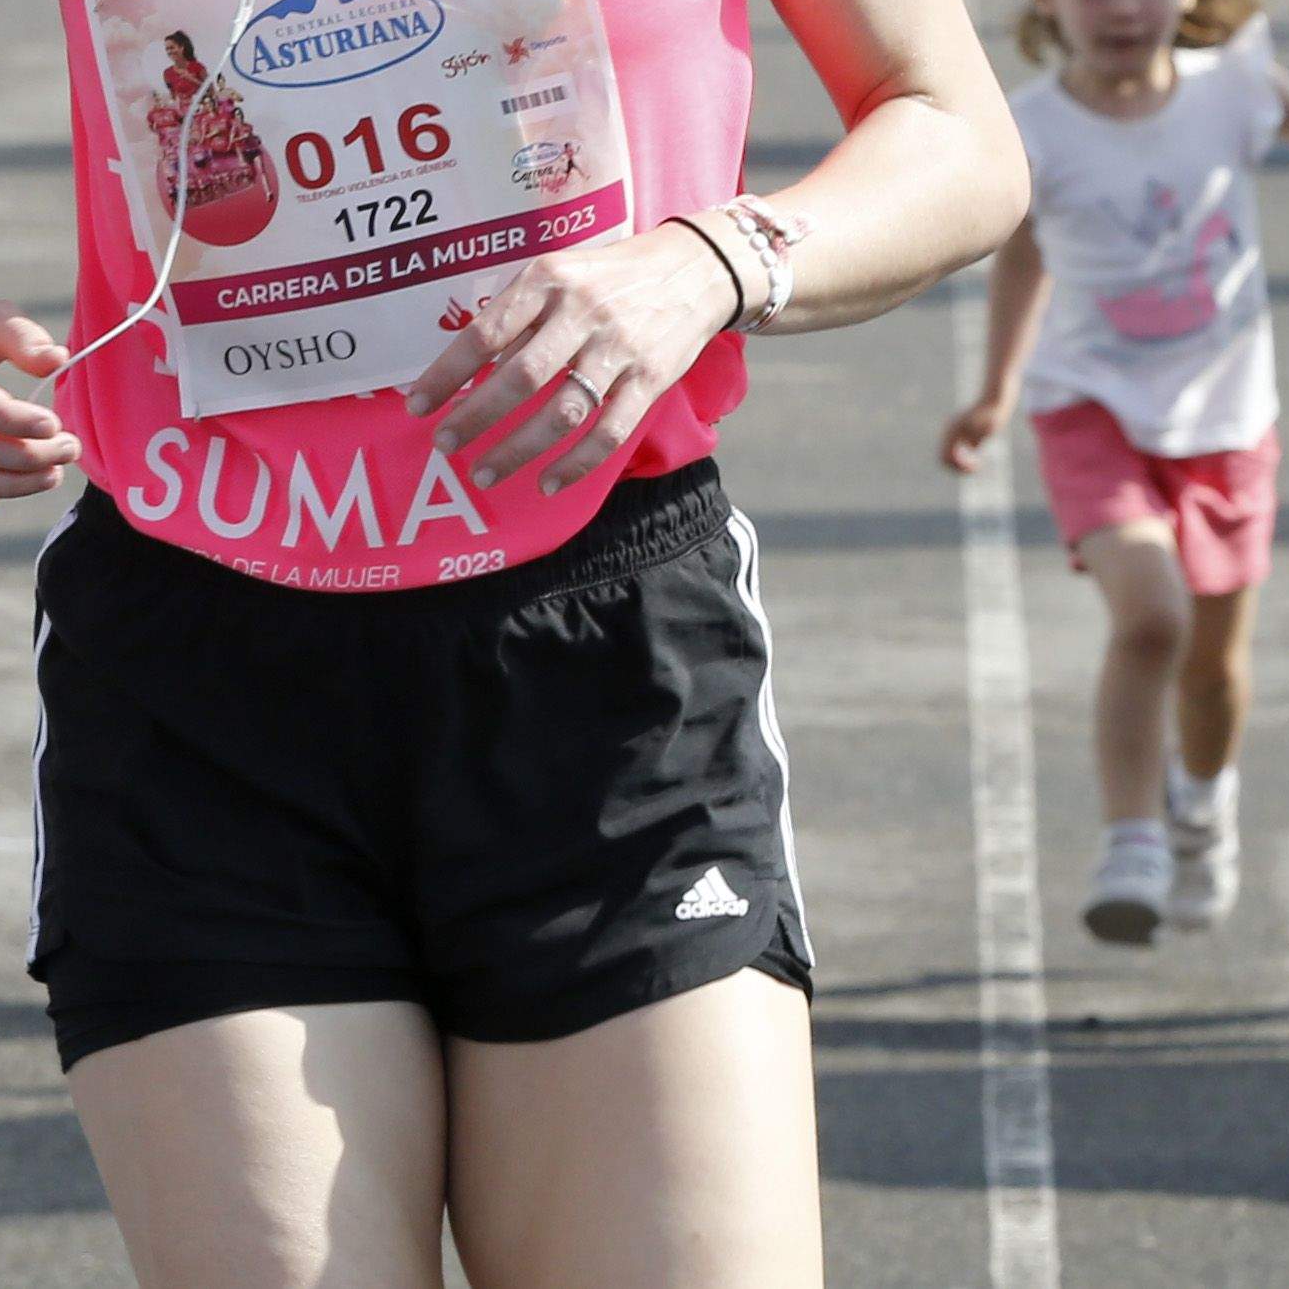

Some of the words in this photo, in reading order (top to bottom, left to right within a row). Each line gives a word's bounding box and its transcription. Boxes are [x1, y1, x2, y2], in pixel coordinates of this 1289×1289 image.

[251, 10, 431, 74] ASTURIANA
[275, 14, 344, 38] CENTRAL
[285, 103, 451, 189] 016
[348, 172, 399, 192] VIOLENCIA
[400, 169, 412, 179] DE
[334, 189, 438, 242] 1722
[217, 276, 341, 309] CARRERA
[346, 261, 383, 289] DE
[390, 255, 427, 279] LA
[432, 226, 526, 267] MUJER
[538, 205, 597, 244] 2023
[223, 329, 357, 376] OYSHO
[126, 426, 489, 553] SUMA
[270, 564, 303, 586] LA
[309, 564, 402, 589] MUJER
[438, 549, 506, 581] 2023
